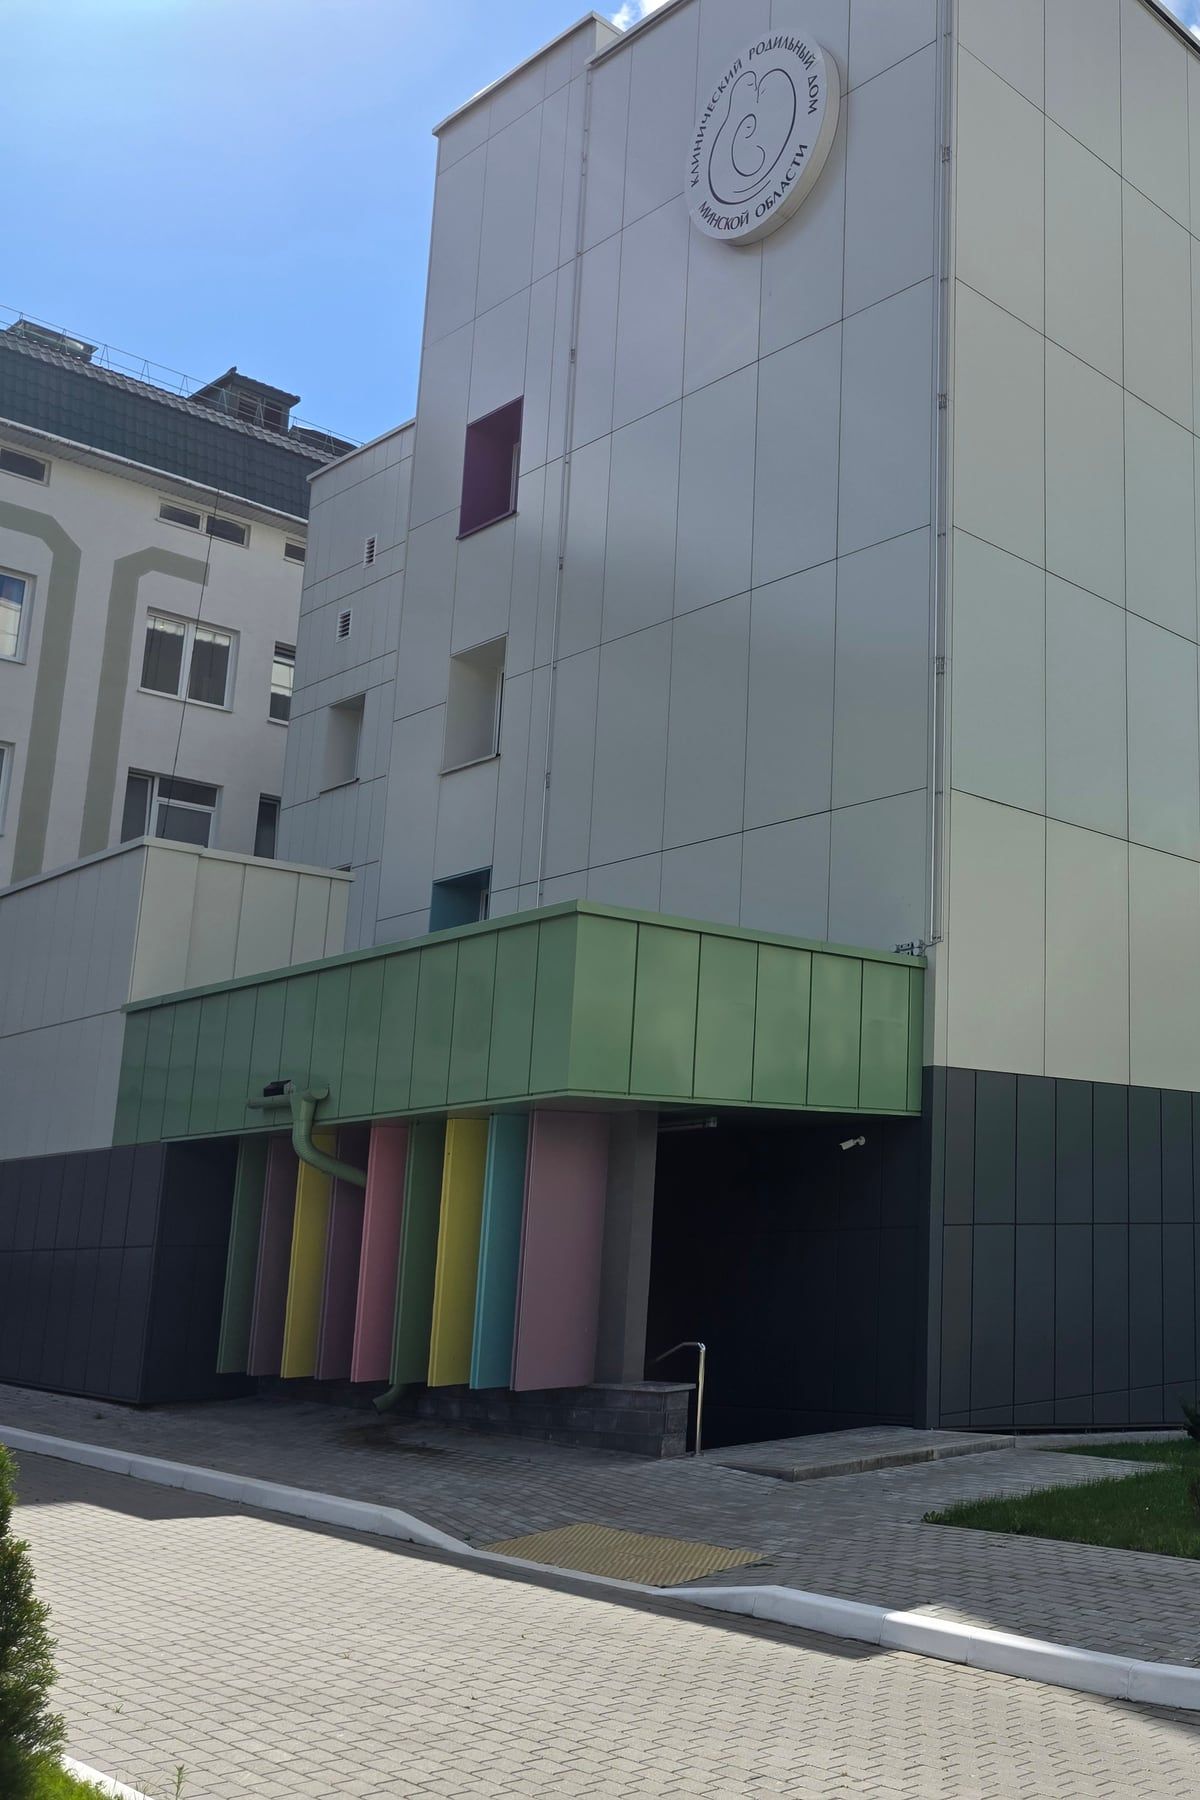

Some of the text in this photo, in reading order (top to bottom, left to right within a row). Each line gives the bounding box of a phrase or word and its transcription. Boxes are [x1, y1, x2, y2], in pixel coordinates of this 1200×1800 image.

[690, 35, 819, 188] КЛИНИЧЕСКИЙ РОДИЛЬНЫЙ ДОМ
[698, 144, 808, 231] МИНСКОЙ ОБЛАСТИ
